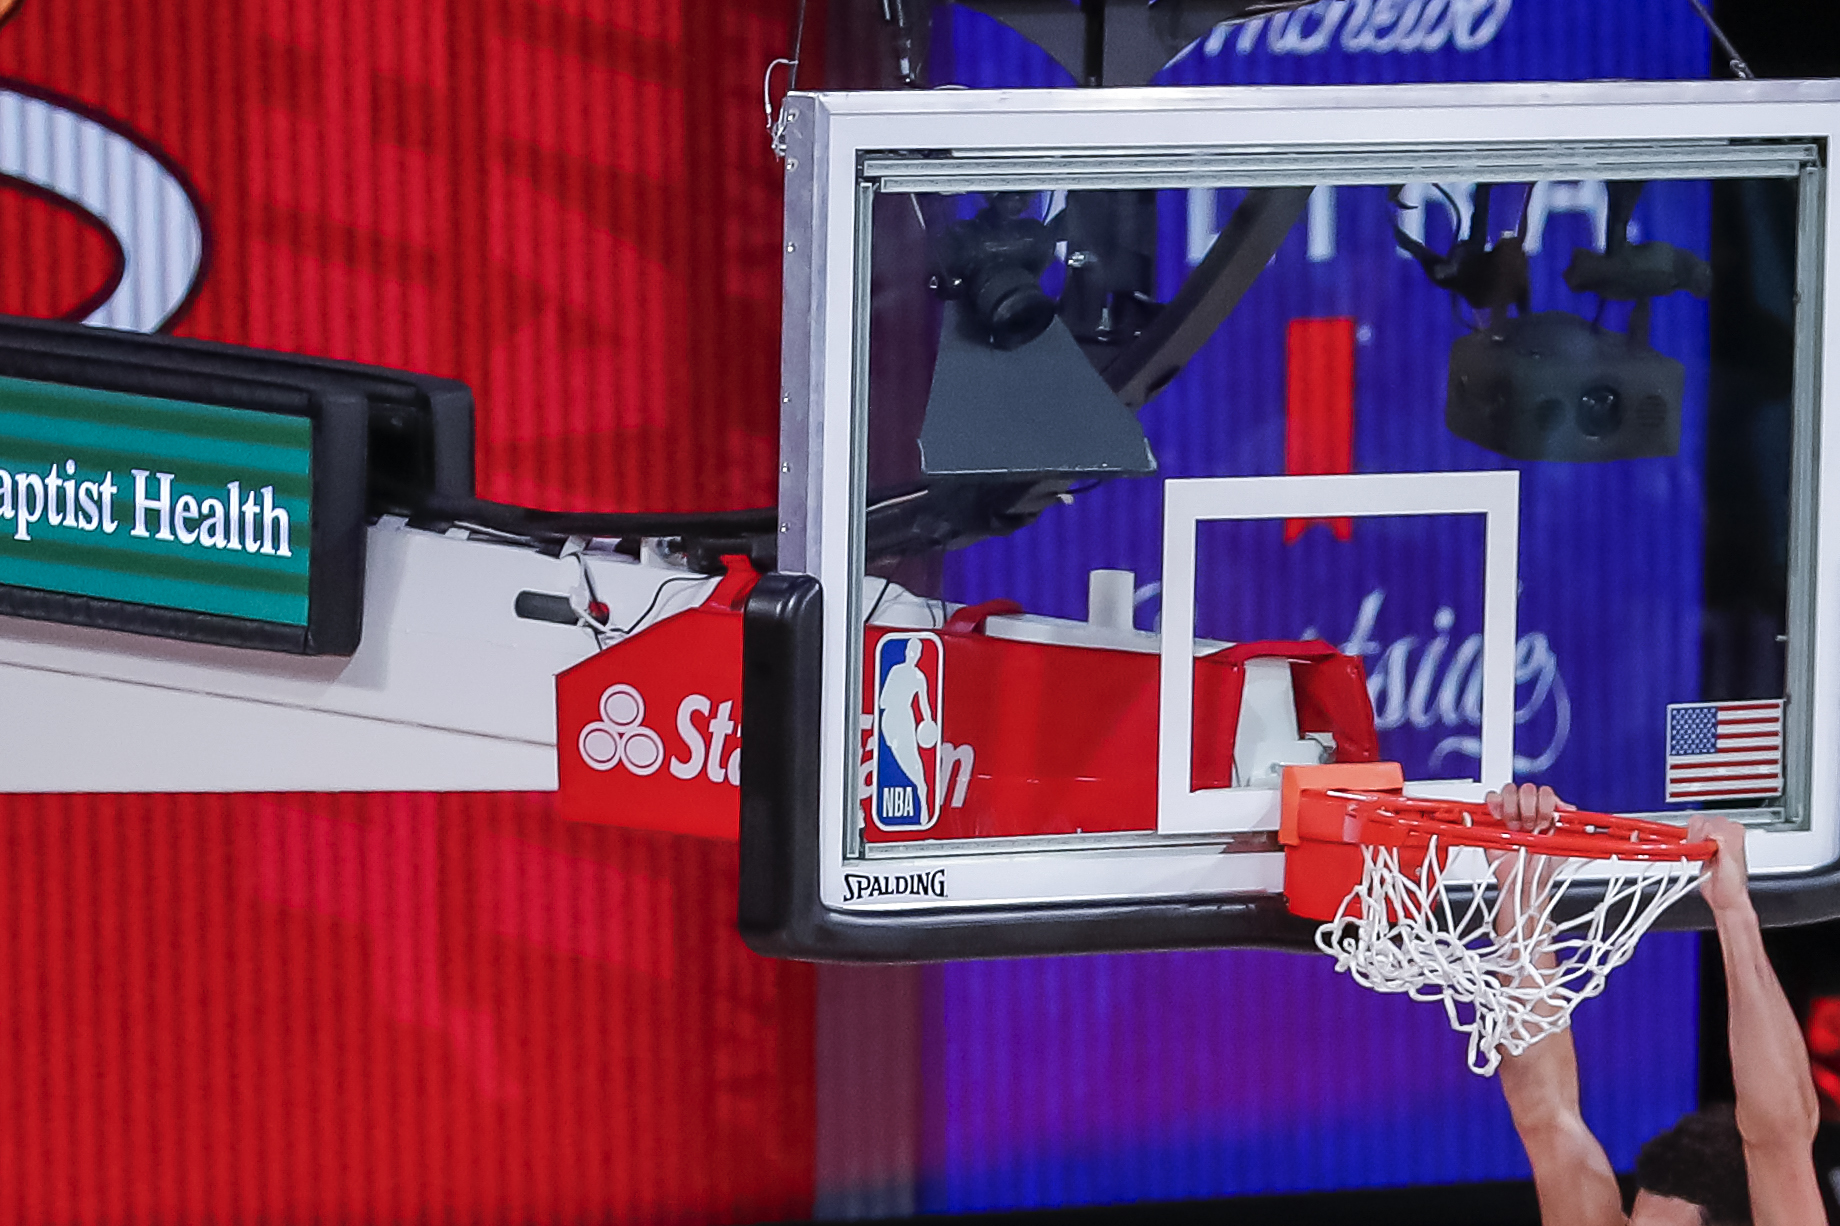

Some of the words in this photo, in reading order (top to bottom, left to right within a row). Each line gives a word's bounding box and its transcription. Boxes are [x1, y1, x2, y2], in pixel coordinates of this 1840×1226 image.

[130, 469, 292, 557] Health
[882, 786, 914, 818] NBA
[843, 868, 948, 902] SPALDING
